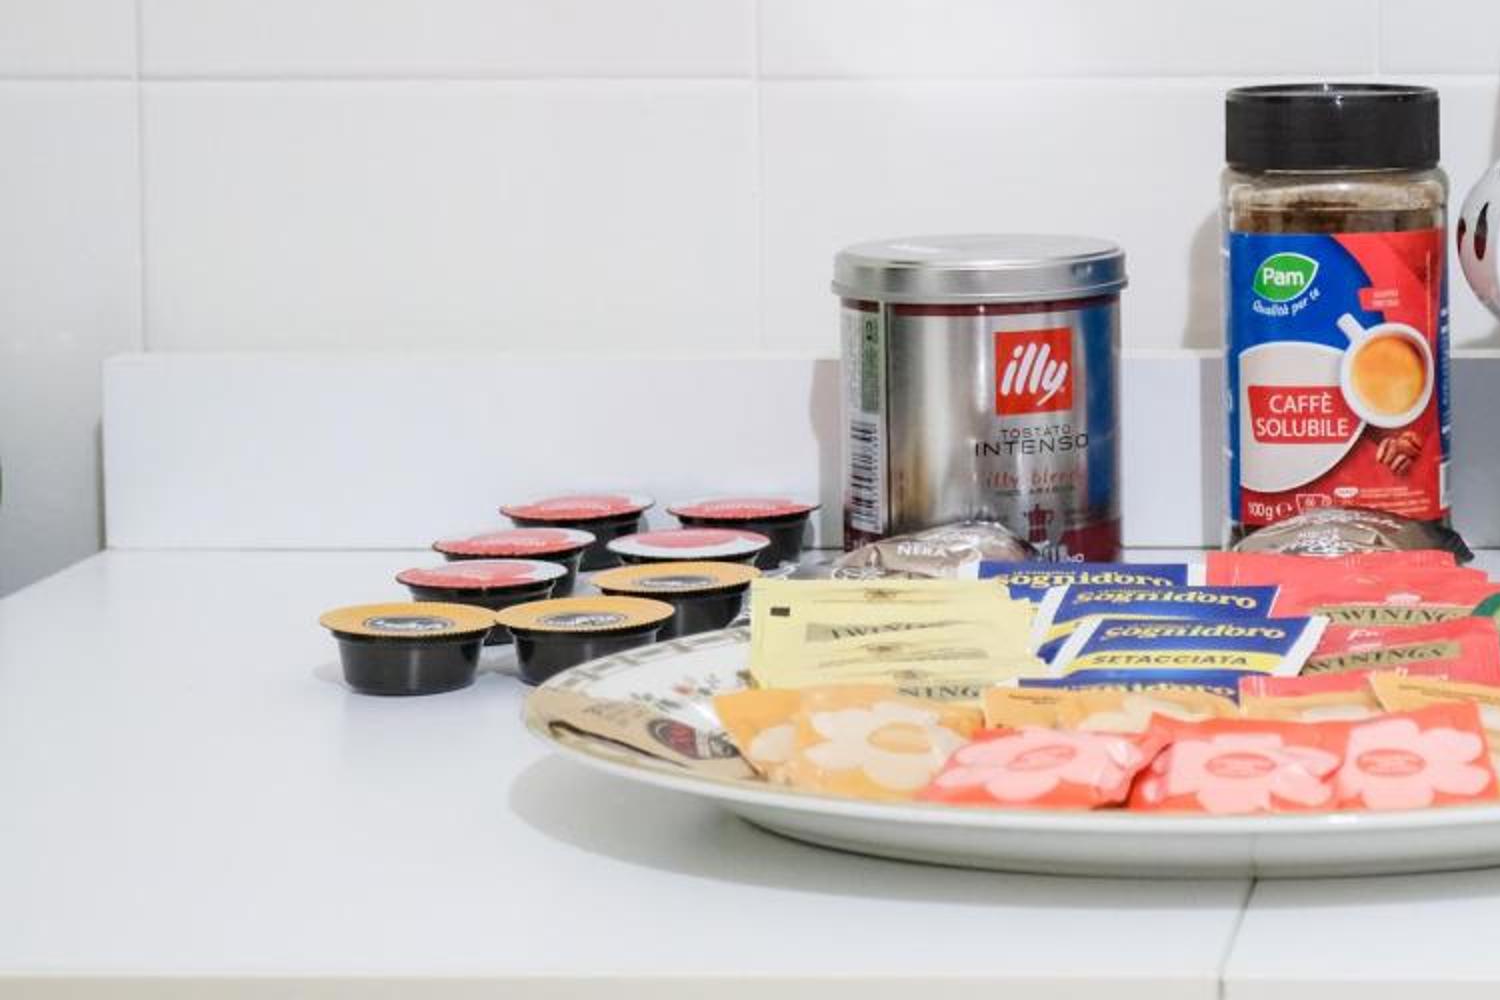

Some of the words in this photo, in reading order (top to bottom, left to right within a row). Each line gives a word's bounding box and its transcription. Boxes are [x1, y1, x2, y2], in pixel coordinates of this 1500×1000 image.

[1262, 266, 1305, 287] Pam
[1000, 343, 1068, 407] illy
[1268, 391, 1334, 414] CAFFÈ
[1000, 424, 1072, 440] TOSTATO
[1255, 417, 1350, 437] SOLUBILE
[975, 433, 1089, 457] INTENSO
[1325, 606, 1446, 624] TWININ
[1092, 654, 1248, 666] SETACCIATA
[1306, 648, 1443, 672] WININGS
